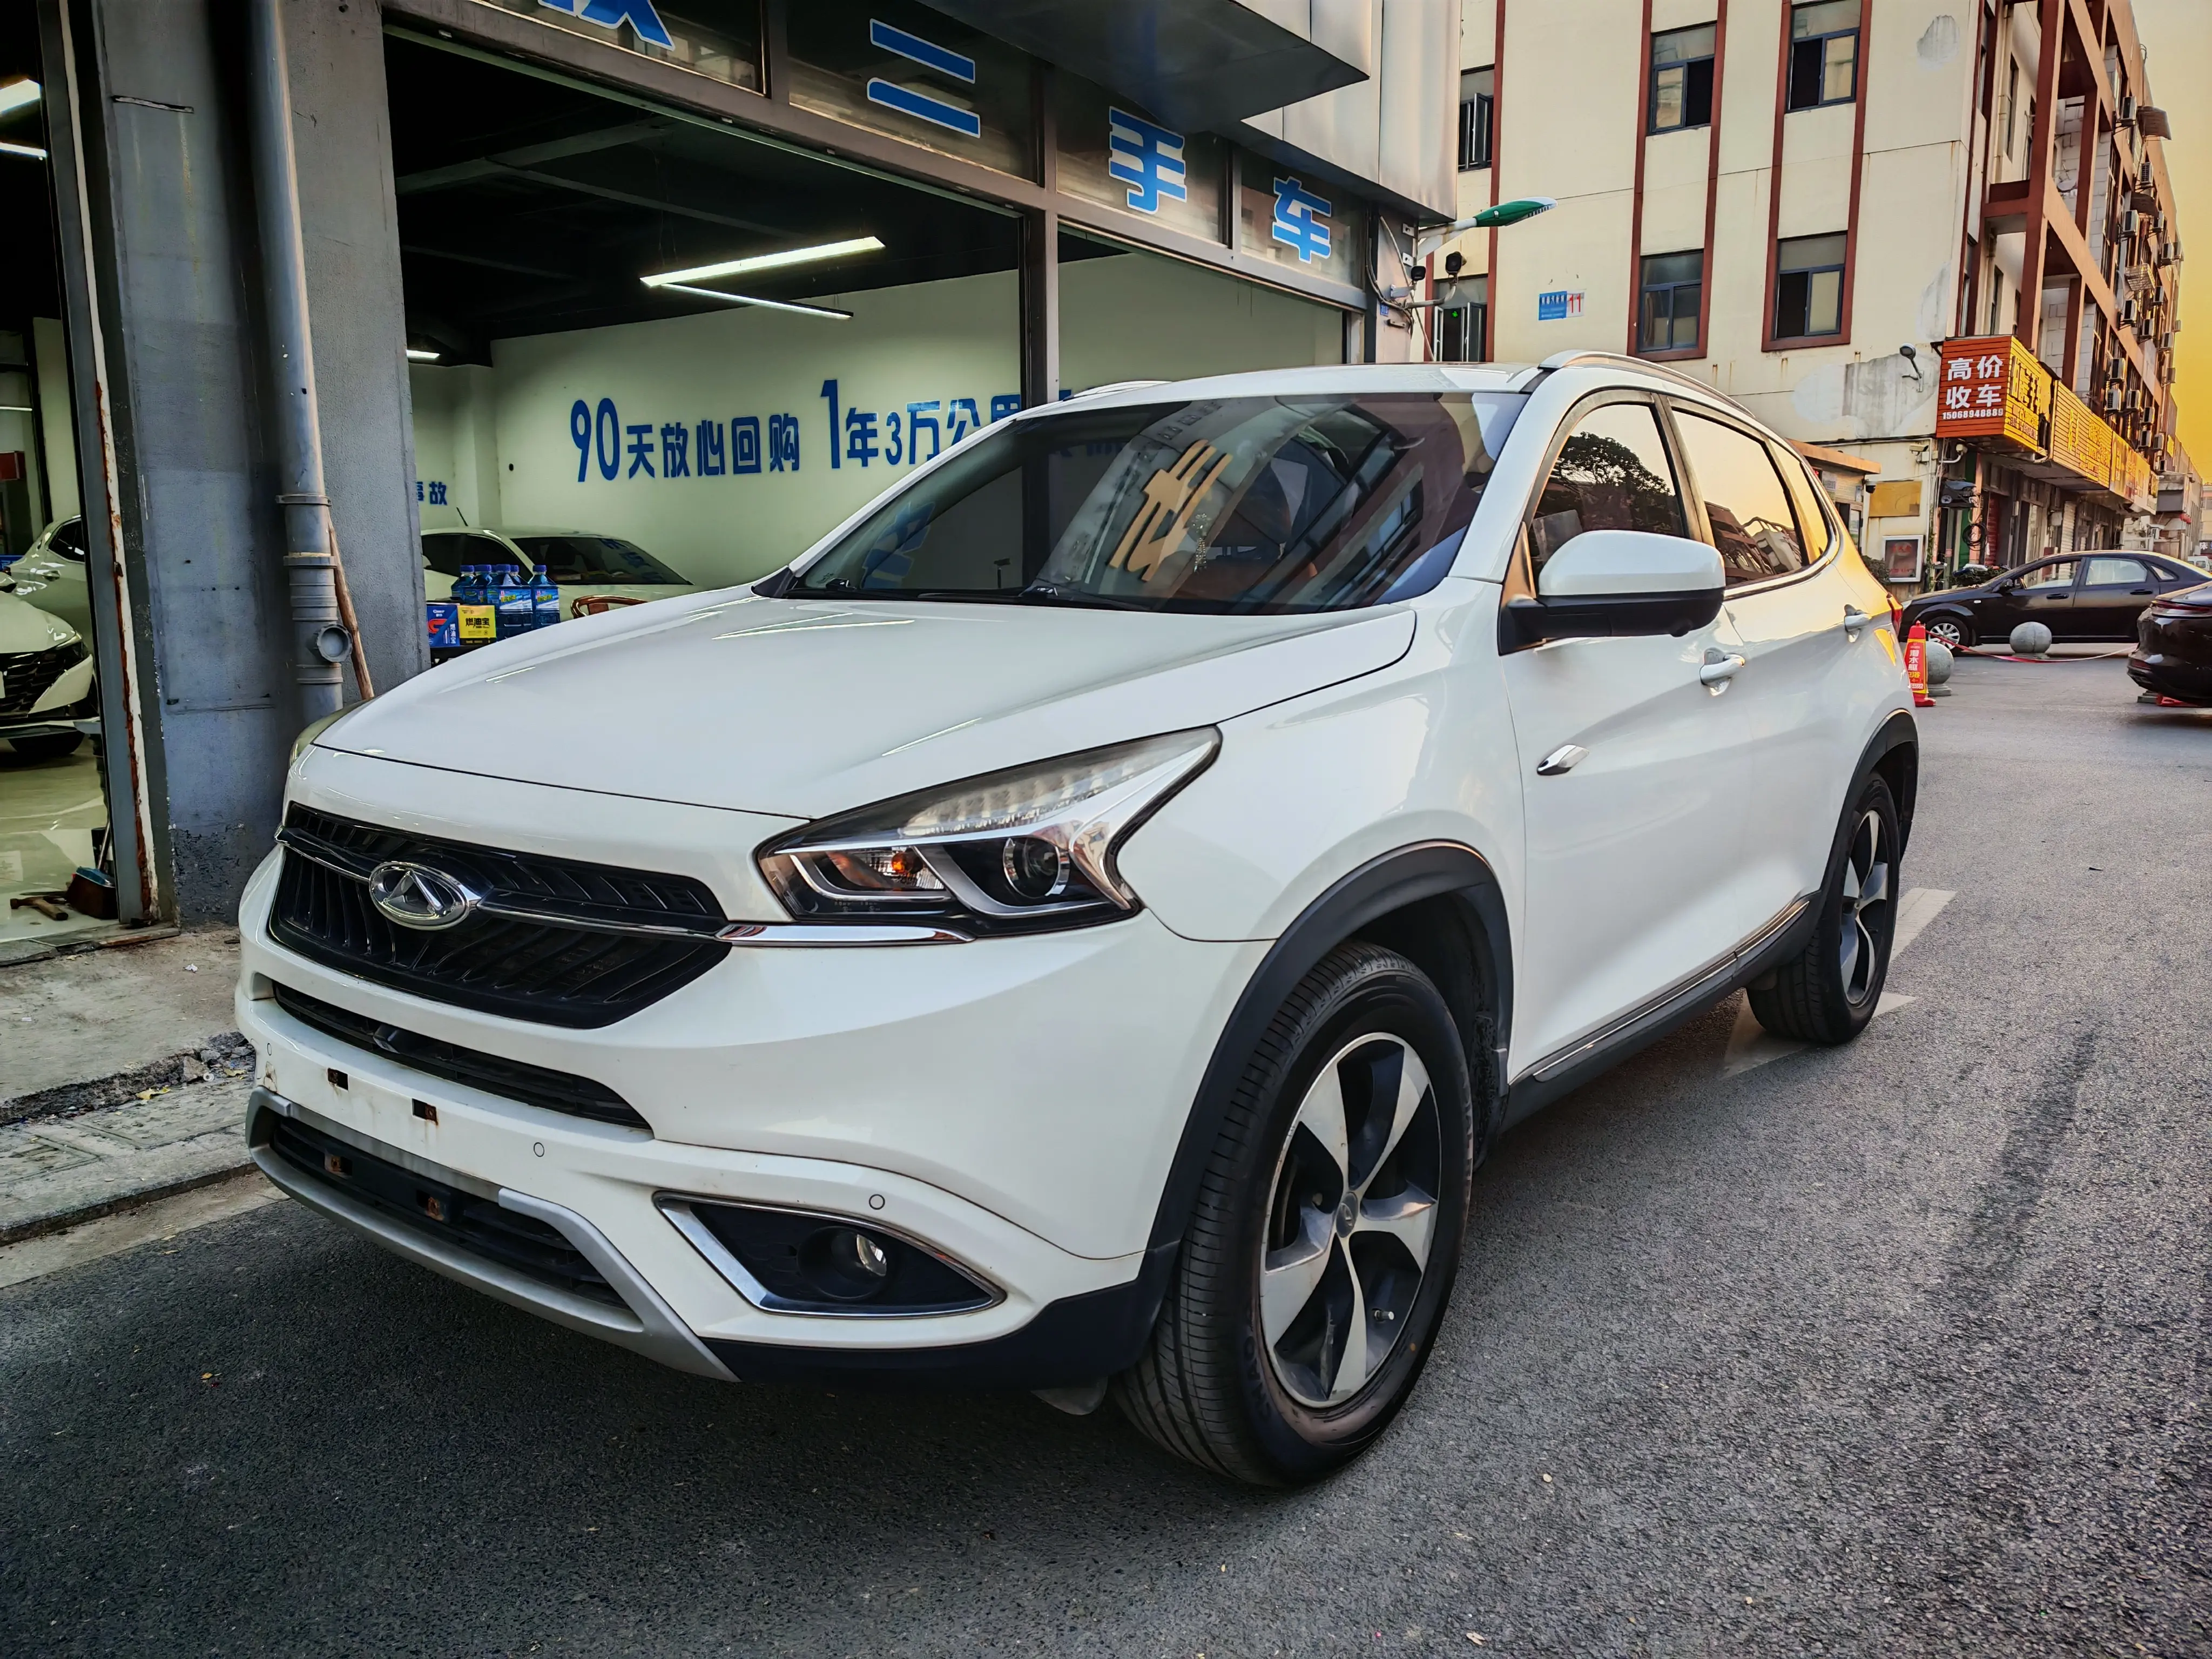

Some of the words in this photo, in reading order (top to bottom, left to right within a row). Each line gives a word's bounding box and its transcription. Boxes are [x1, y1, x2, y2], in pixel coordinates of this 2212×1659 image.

[1569, 293, 1581, 314] 11
[1947, 354, 2004, 381] 高价
[1945, 384, 2002, 409] 收车
[570, 397, 800, 482] 90天放心回购
[466, 617, 490, 628] 燃油宝
